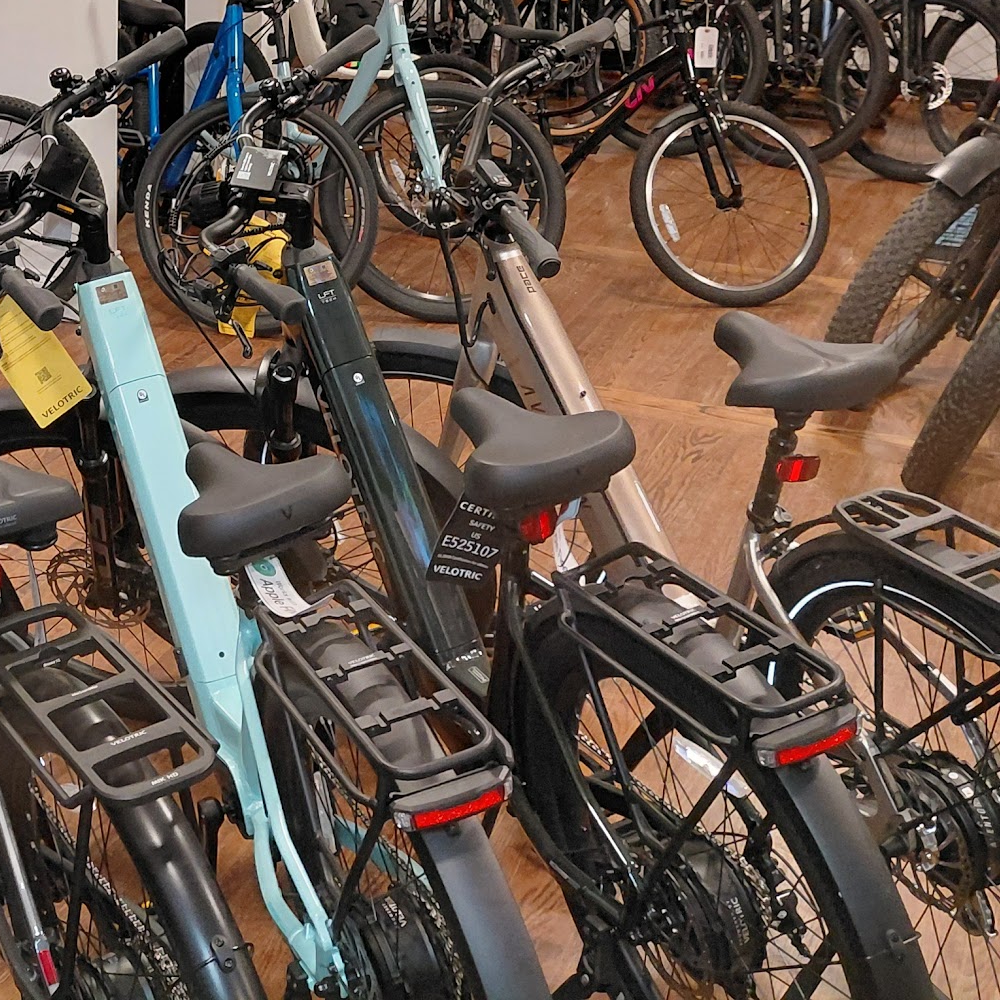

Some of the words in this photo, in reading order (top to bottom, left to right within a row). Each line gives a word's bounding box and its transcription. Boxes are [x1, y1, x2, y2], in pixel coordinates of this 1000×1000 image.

[144, 184, 153, 229] KENDA
[42, 385, 83, 419] VELOTRIC
[460, 501, 495, 520] CERTI
[469, 519, 496, 532] SAFETY
[470, 531, 482, 540] US
[441, 535, 499, 559] E525107
[433, 564, 483, 581] VELOTRIC
[260, 578, 285, 606] Apple
[110, 729, 147, 746] VELOTRIC
